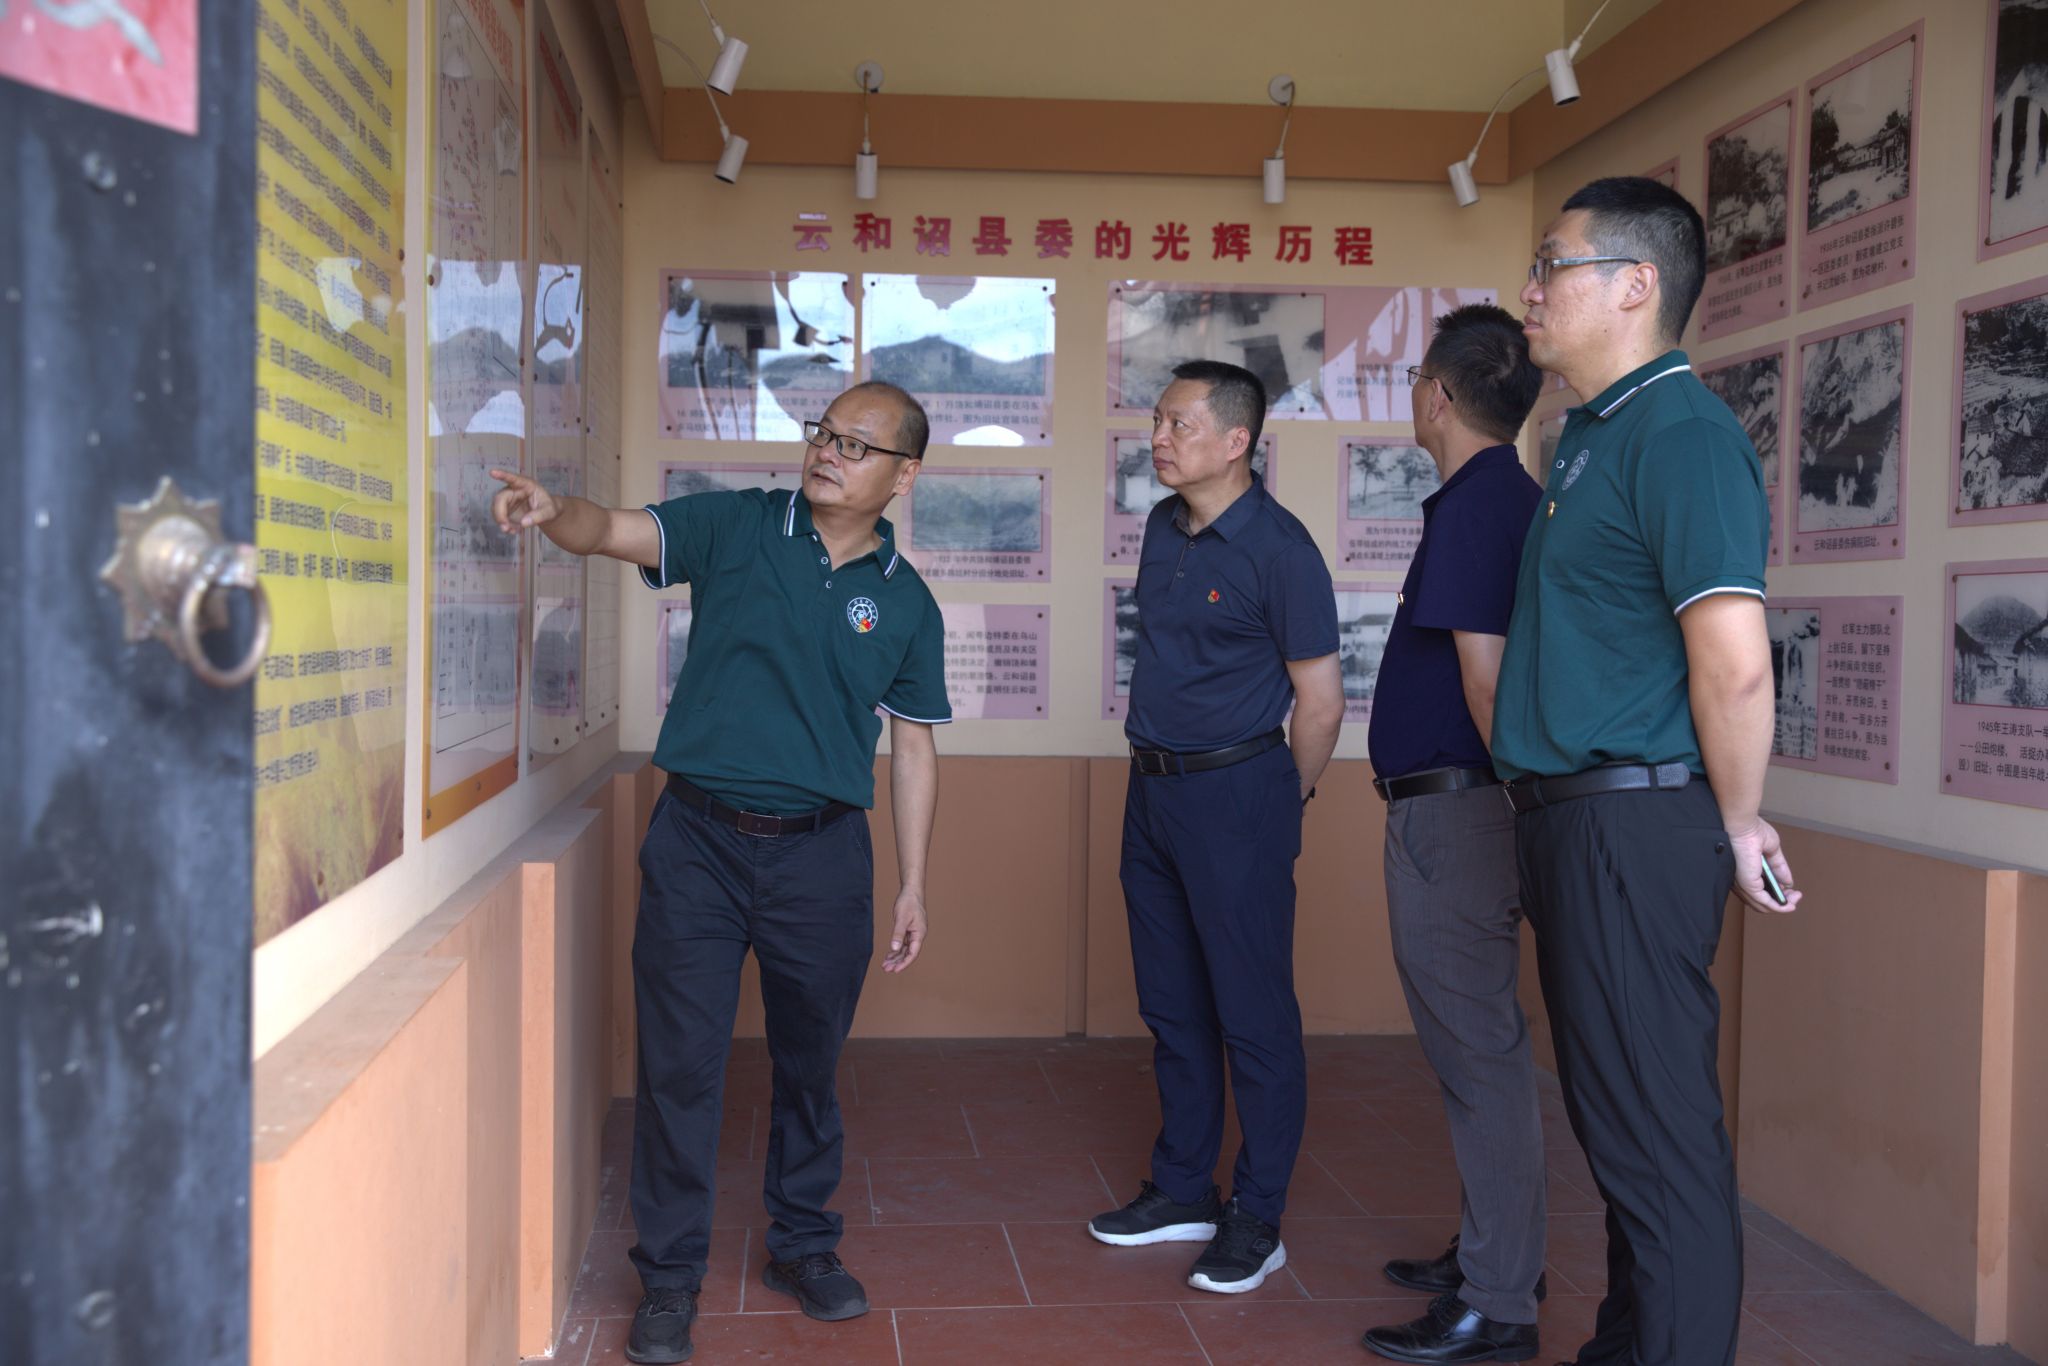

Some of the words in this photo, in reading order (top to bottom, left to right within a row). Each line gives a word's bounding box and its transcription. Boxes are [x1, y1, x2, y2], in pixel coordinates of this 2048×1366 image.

[793, 212, 1373, 266] 云和诏县委的光辉历程
